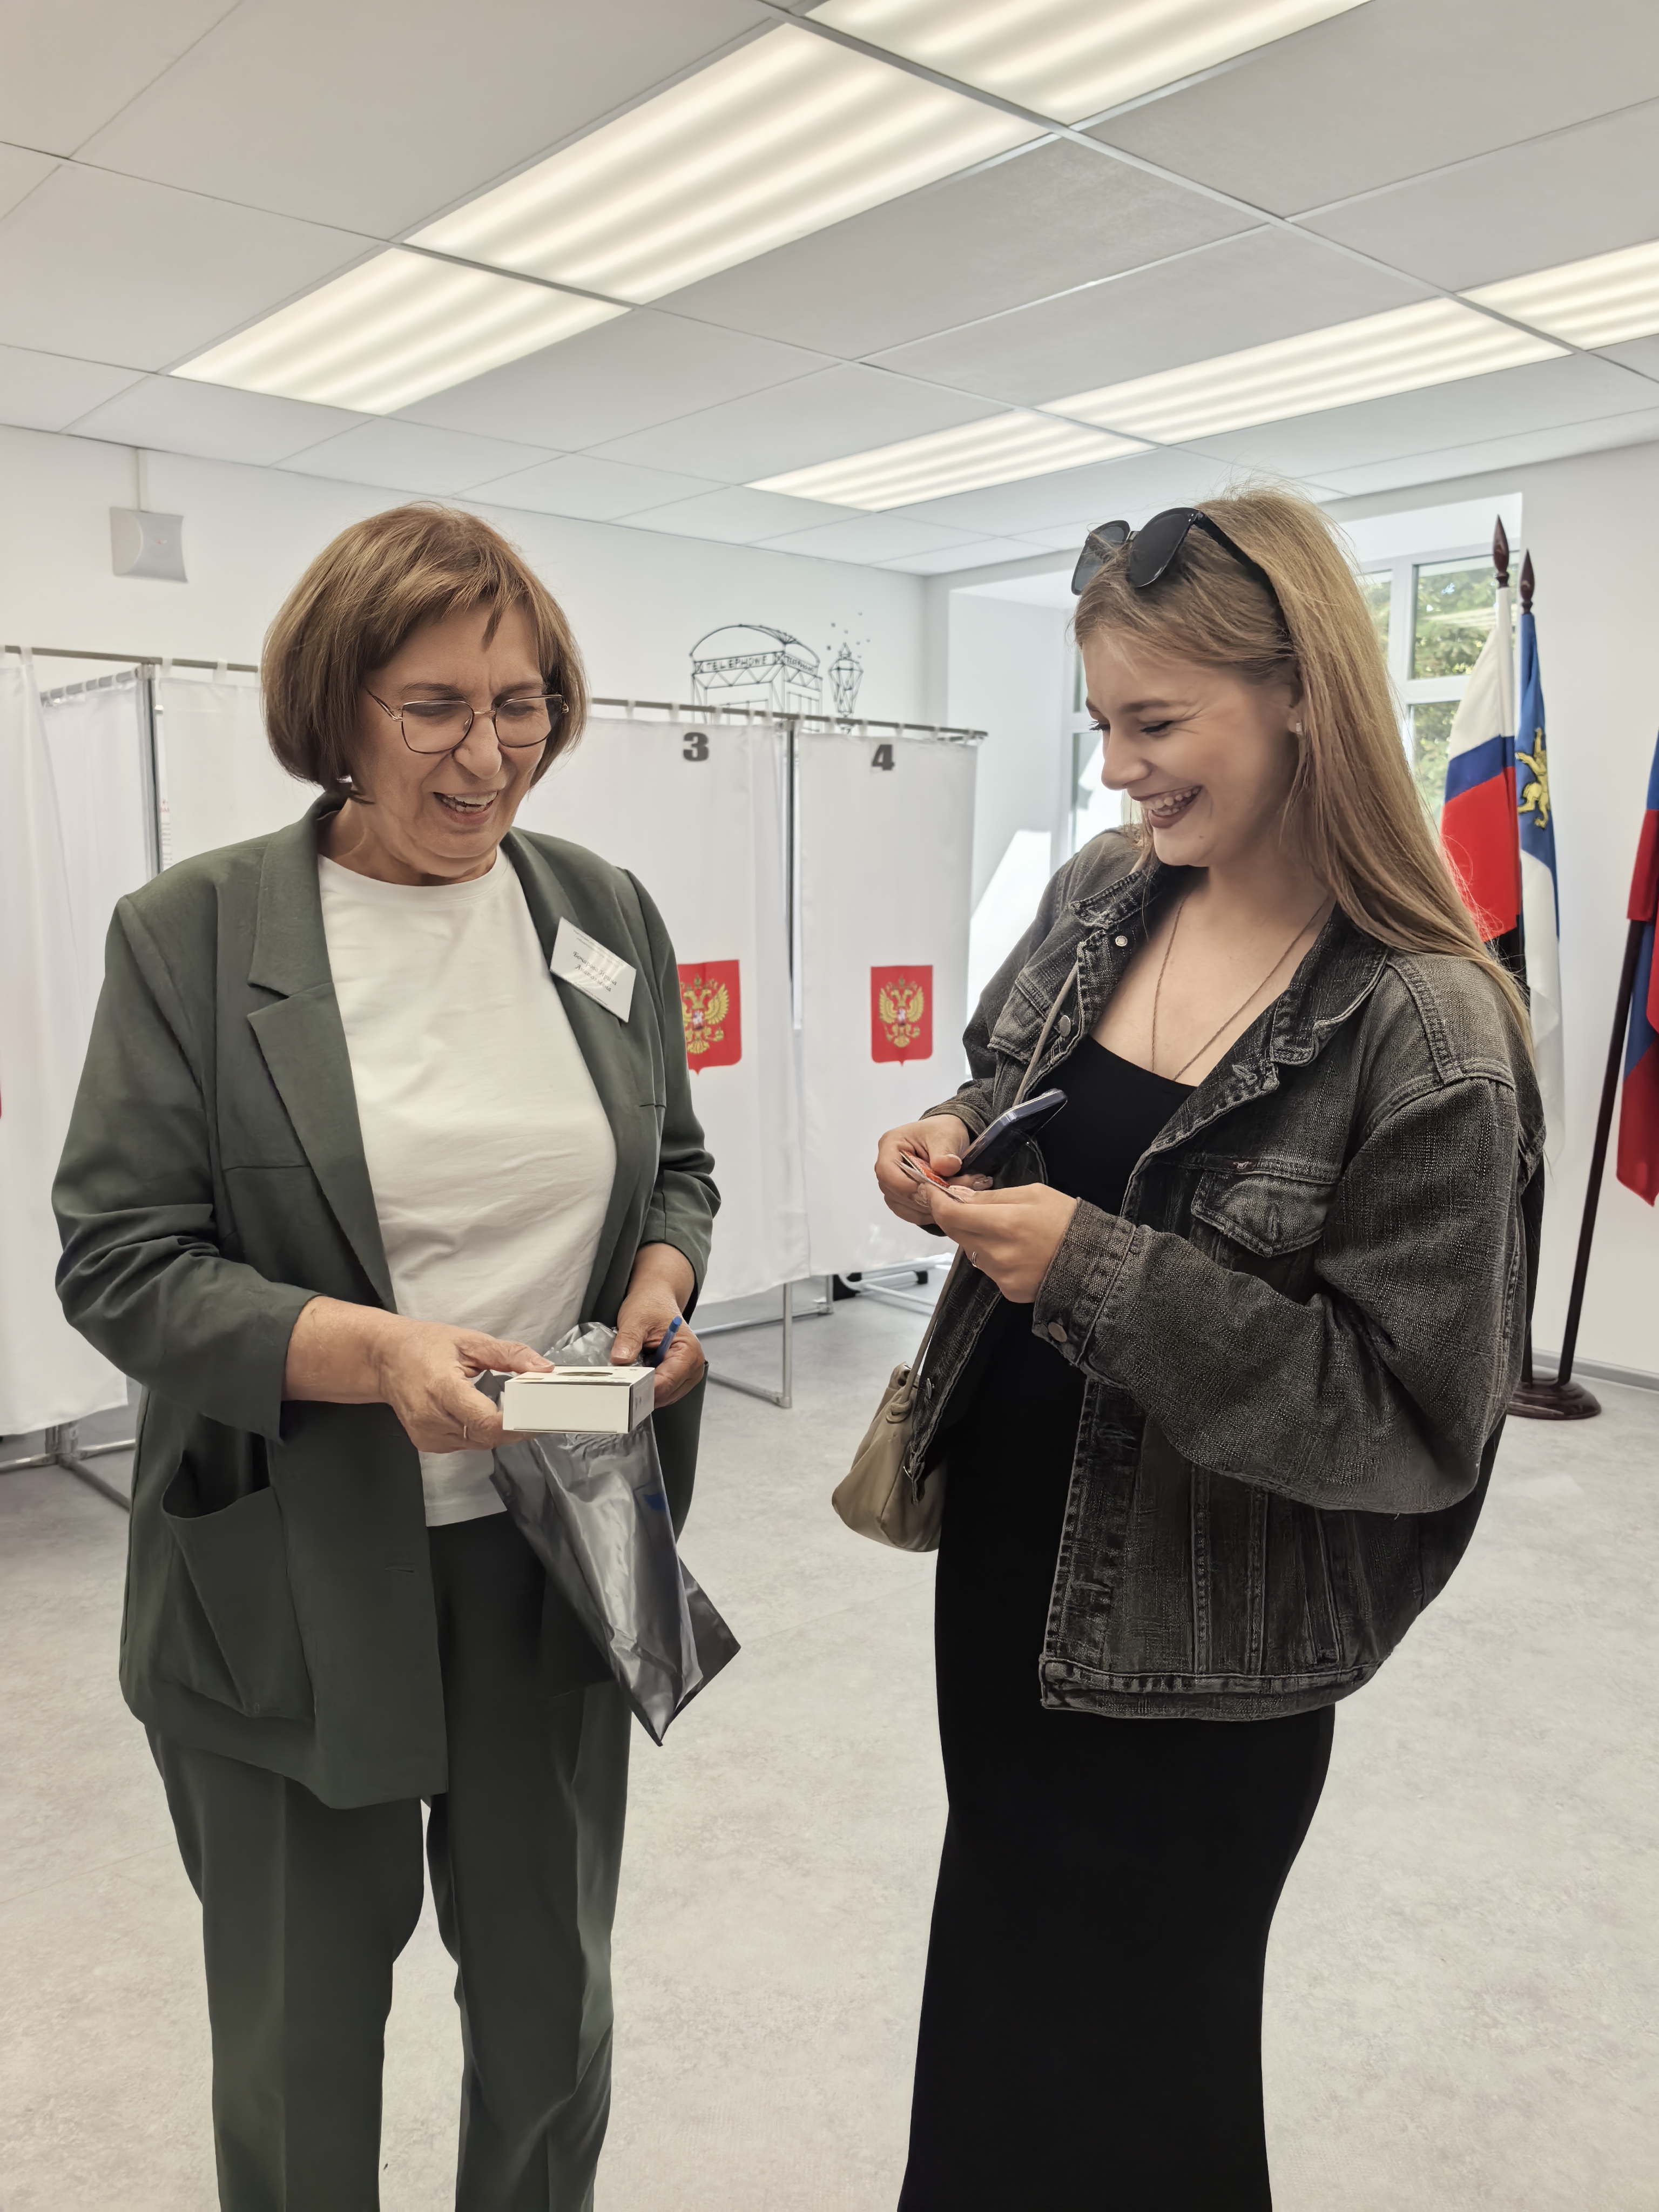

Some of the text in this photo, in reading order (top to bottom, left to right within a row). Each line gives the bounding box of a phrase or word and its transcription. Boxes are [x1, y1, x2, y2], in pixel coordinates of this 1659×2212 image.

[706, 655, 768, 670] TELEPHONE
[683, 732, 709, 761] 3
[872, 744, 895, 771] 4
[573, 951, 599, 973] Бочарова
